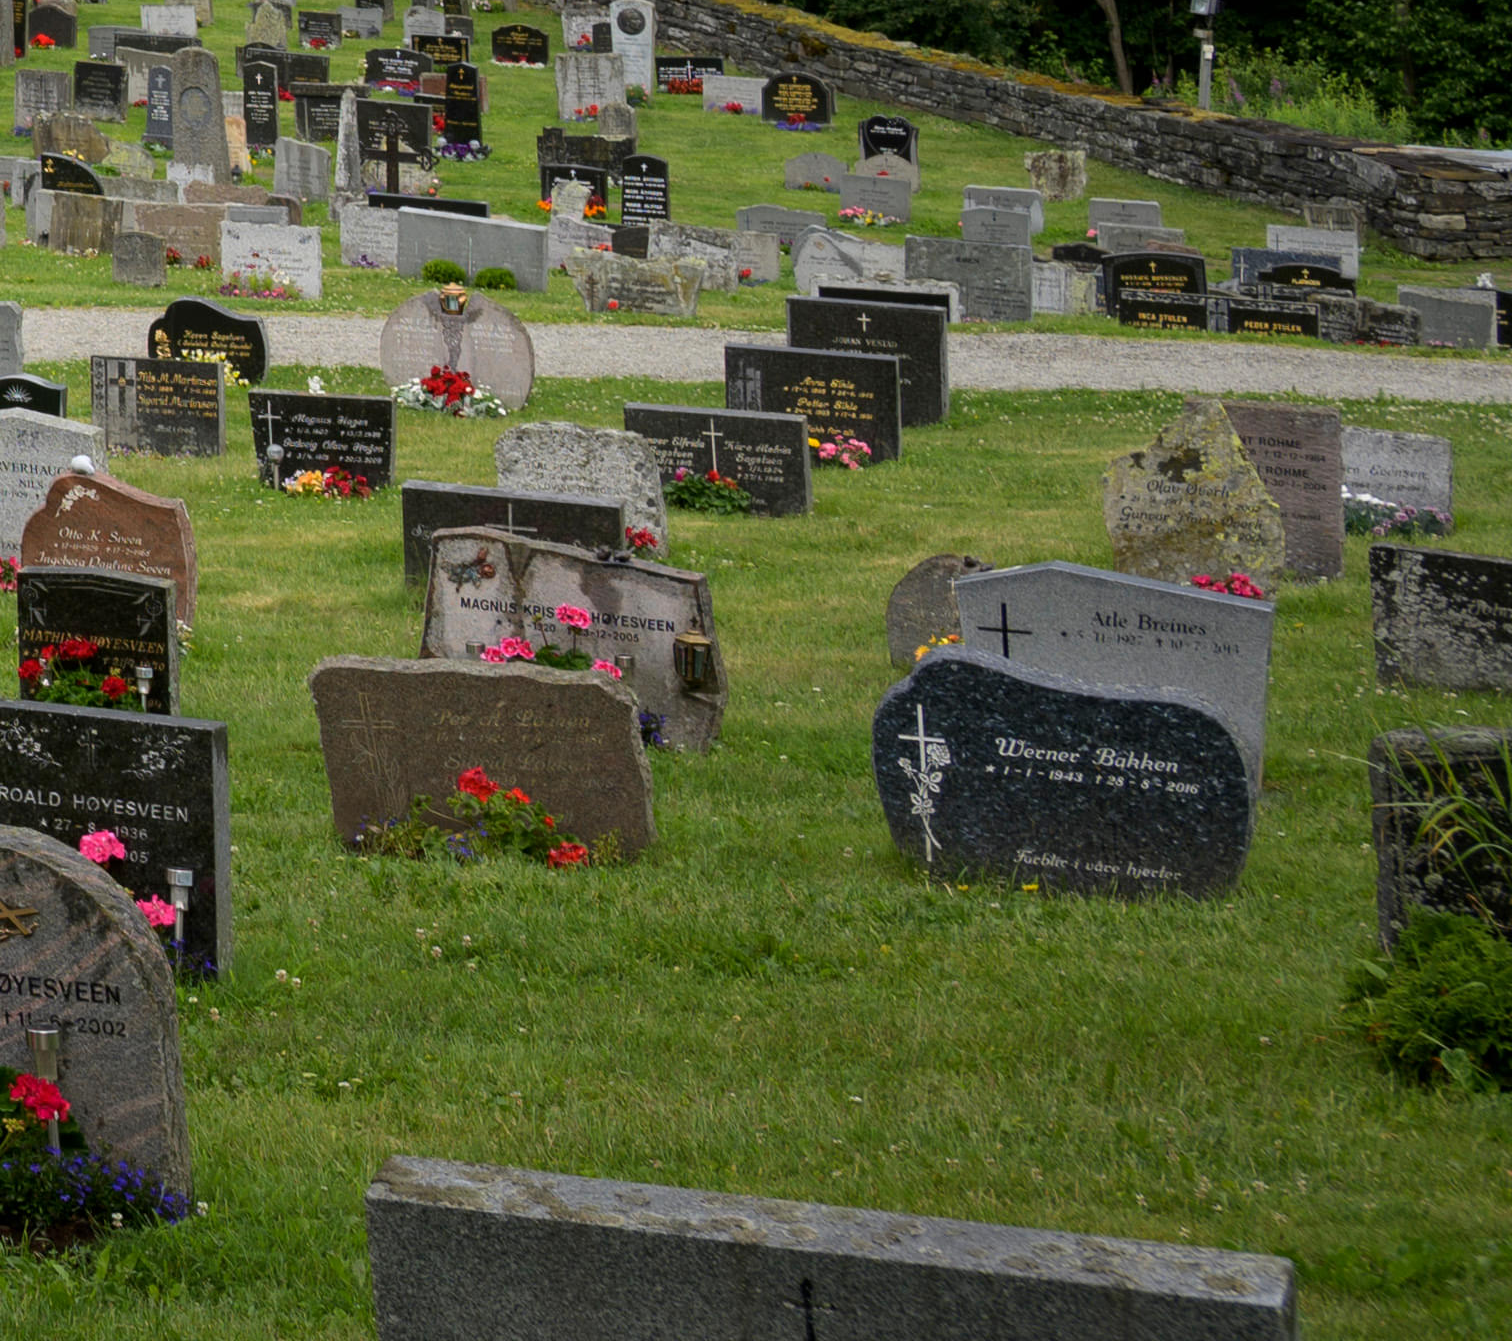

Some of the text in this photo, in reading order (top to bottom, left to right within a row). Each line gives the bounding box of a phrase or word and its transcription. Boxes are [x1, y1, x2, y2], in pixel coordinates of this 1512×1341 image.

[460, 597, 675, 634] MAGNUS HØYESVEEN
[1092, 611, 1207, 637] Atle Breines
[994, 737, 1180, 775] Werner Bakken
[73, 794, 190, 824] HØYESVEEN
[1084, 860, 1122, 876] våre
[1126, 861, 1183, 882] hjerter
